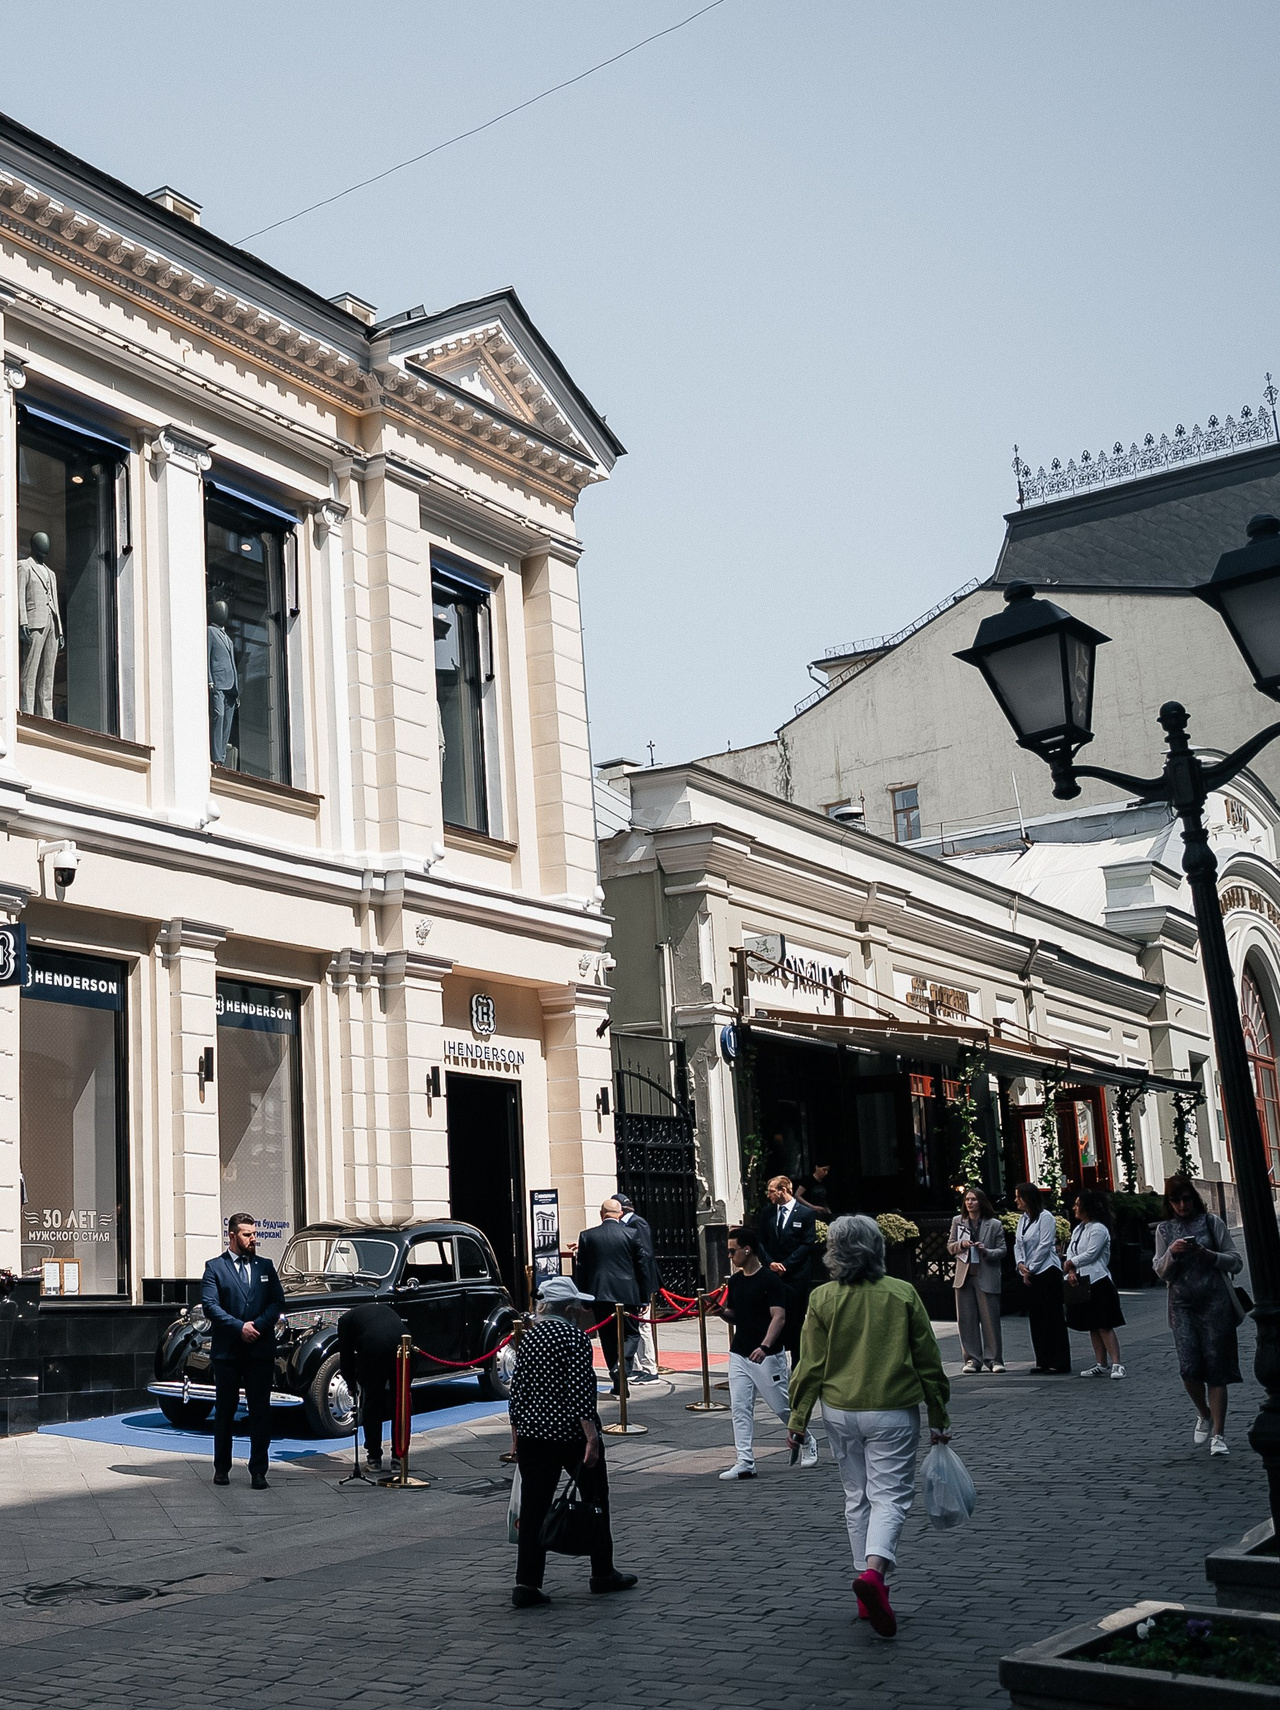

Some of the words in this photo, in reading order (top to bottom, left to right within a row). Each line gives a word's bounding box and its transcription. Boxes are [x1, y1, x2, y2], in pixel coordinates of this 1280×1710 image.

[34, 969, 117, 995] HENDERSON
[226, 1000, 292, 1020] HENDERSON
[447, 1040, 525, 1065] HENDERSON
[42, 1209, 62, 1229] 30
[66, 1210, 97, 1229] ЛЕТ
[262, 1218, 290, 1230] будущее
[28, 1230, 80, 1241] МУЖСКОГО
[81, 1231, 110, 1242] СТИЛЯ
